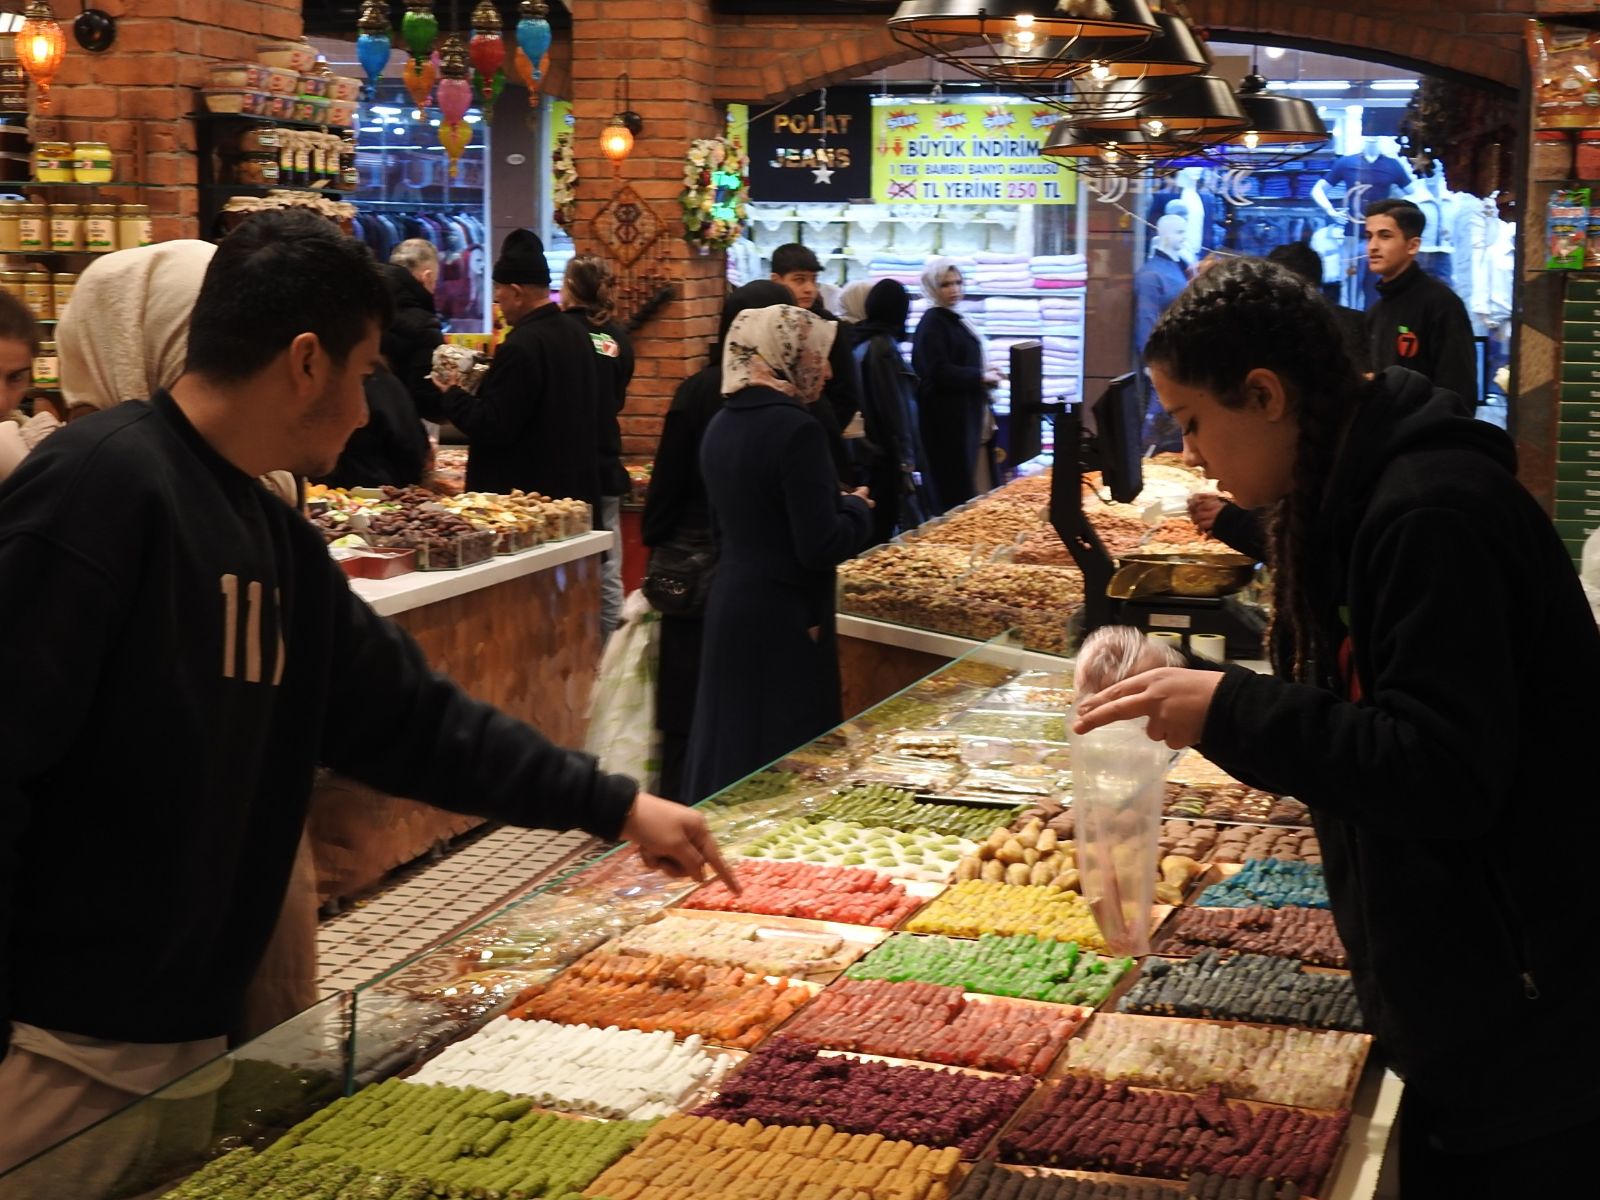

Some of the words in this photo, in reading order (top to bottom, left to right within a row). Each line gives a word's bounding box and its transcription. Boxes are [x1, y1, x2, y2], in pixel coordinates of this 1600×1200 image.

[774, 114, 852, 134] POLAT
[908, 134, 966, 157] BÜYÜK
[972, 134, 1040, 157] İNDİRİM
[768, 148, 850, 168] JEANS
[899, 164, 918, 175] TEK
[925, 164, 963, 175] BAMBU
[968, 164, 1003, 175] BANYO
[922, 182, 940, 198] TL
[945, 178, 1001, 198] YERİNE
[1007, 182, 1037, 198] 250
[1044, 182, 1061, 198] TL
